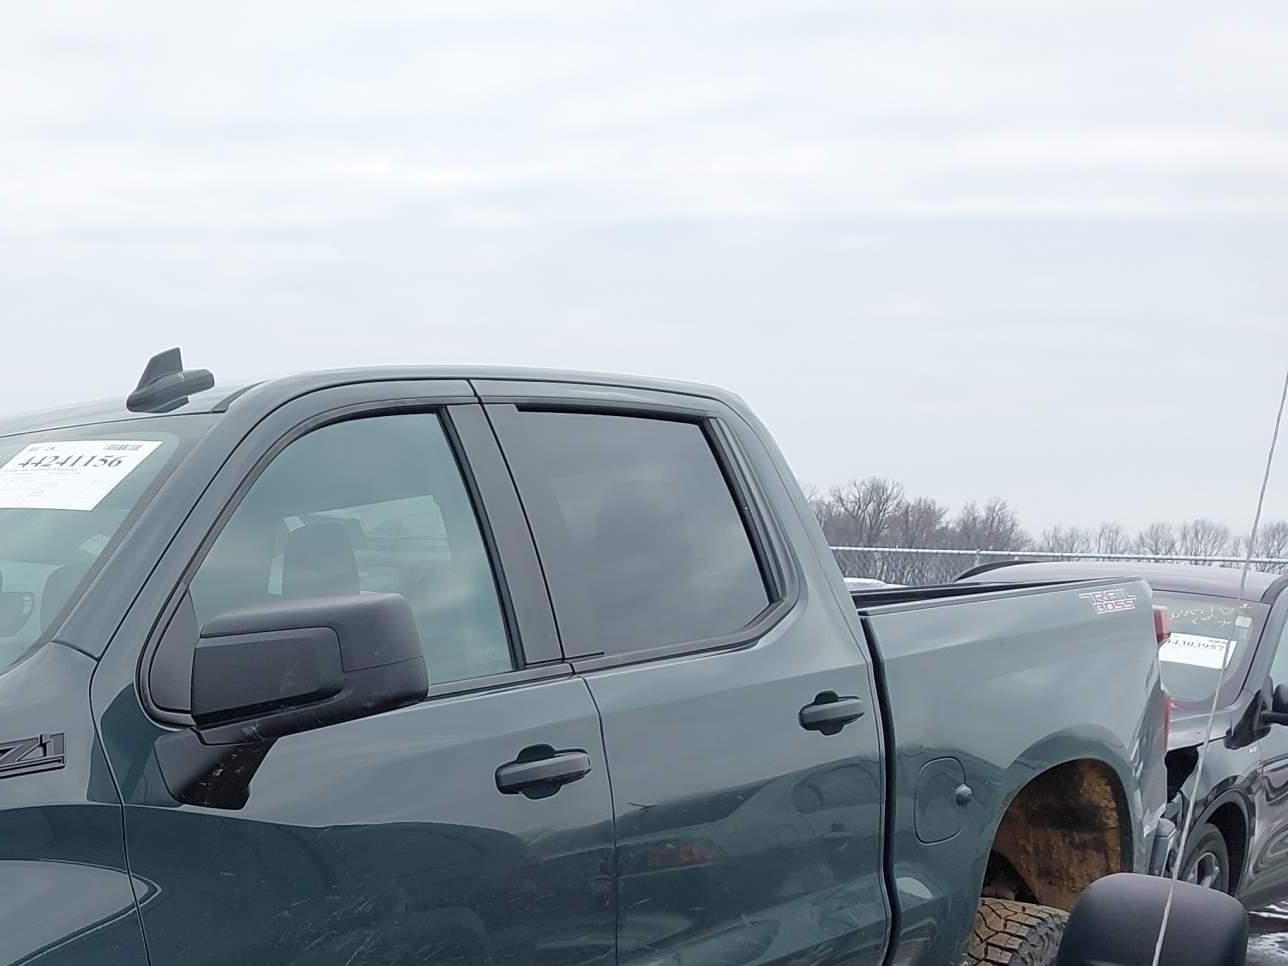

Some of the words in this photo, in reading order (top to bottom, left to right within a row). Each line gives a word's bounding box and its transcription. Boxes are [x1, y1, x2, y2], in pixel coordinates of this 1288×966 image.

[17, 454, 127, 468] 44241156
[1078, 588, 1136, 605] TRAIL
[1093, 600, 1136, 614] BOSS
